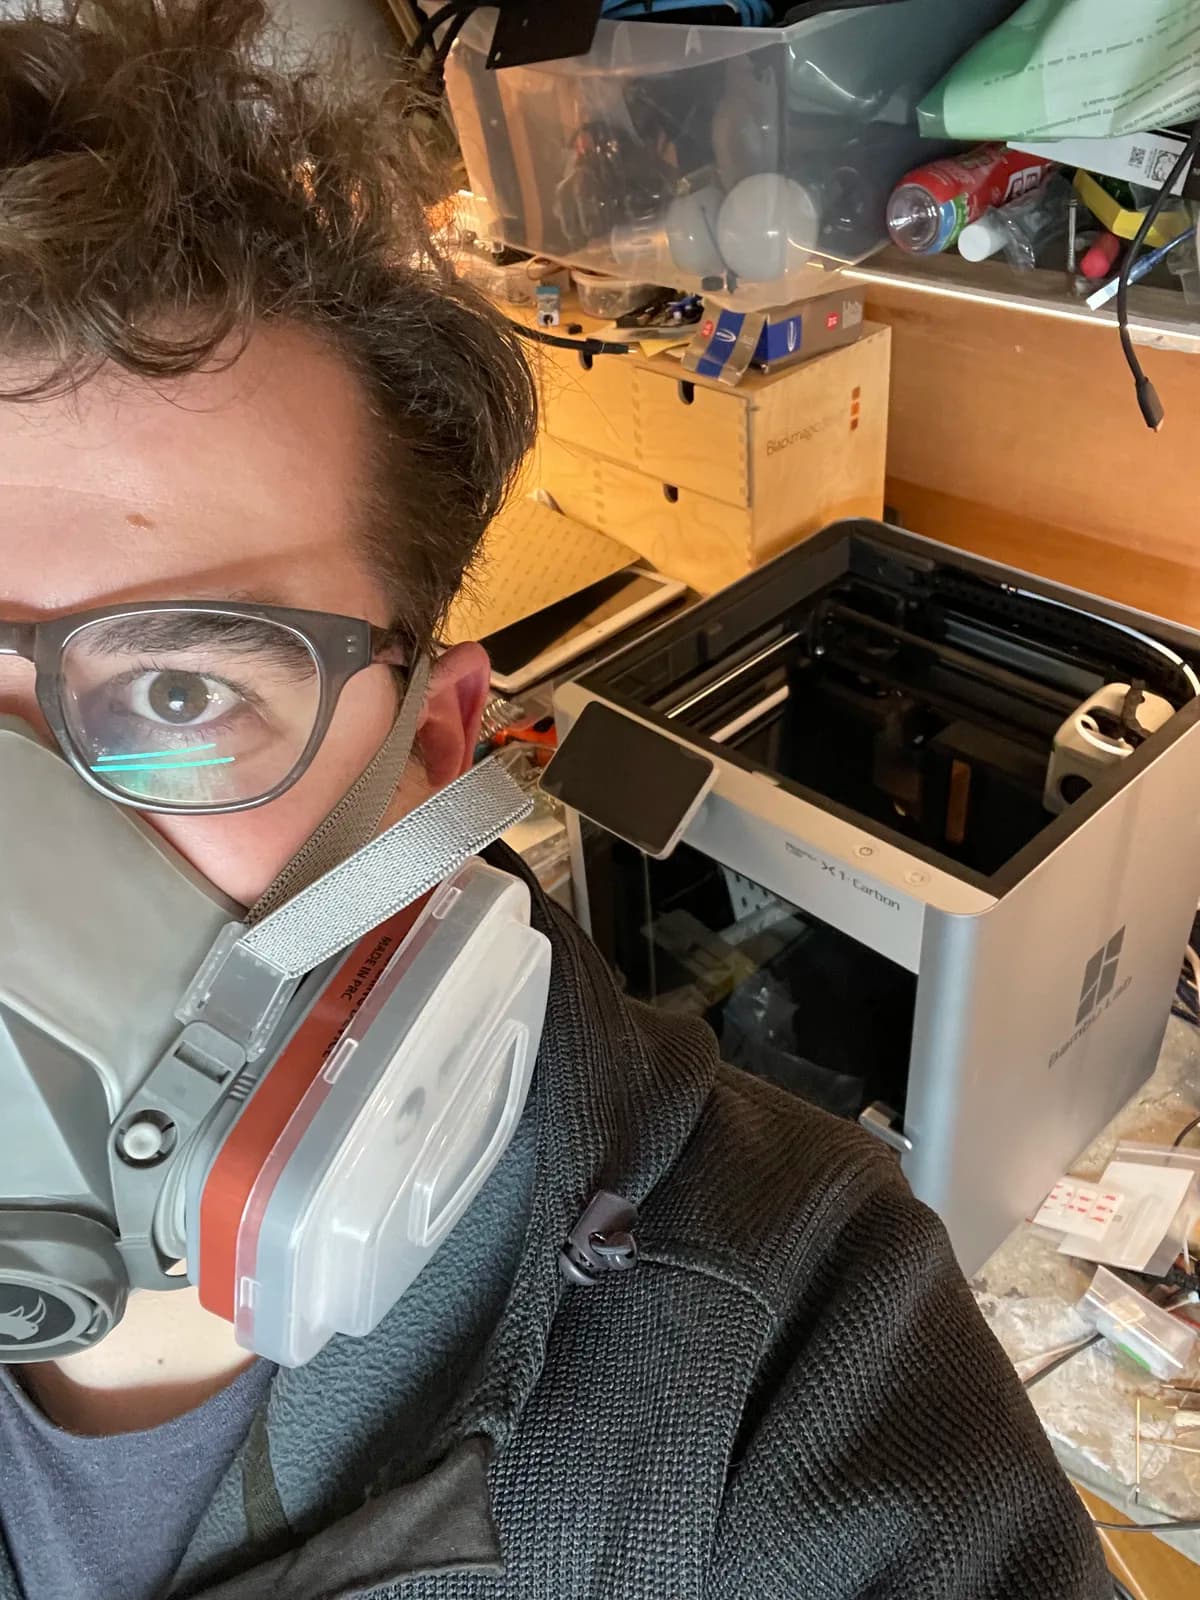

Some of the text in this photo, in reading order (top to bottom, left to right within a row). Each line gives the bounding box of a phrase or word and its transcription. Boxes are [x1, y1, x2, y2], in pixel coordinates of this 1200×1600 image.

[365, 935, 392, 967] MADE
[356, 966, 372, 979] IN
[340, 979, 363, 1002] PRC
